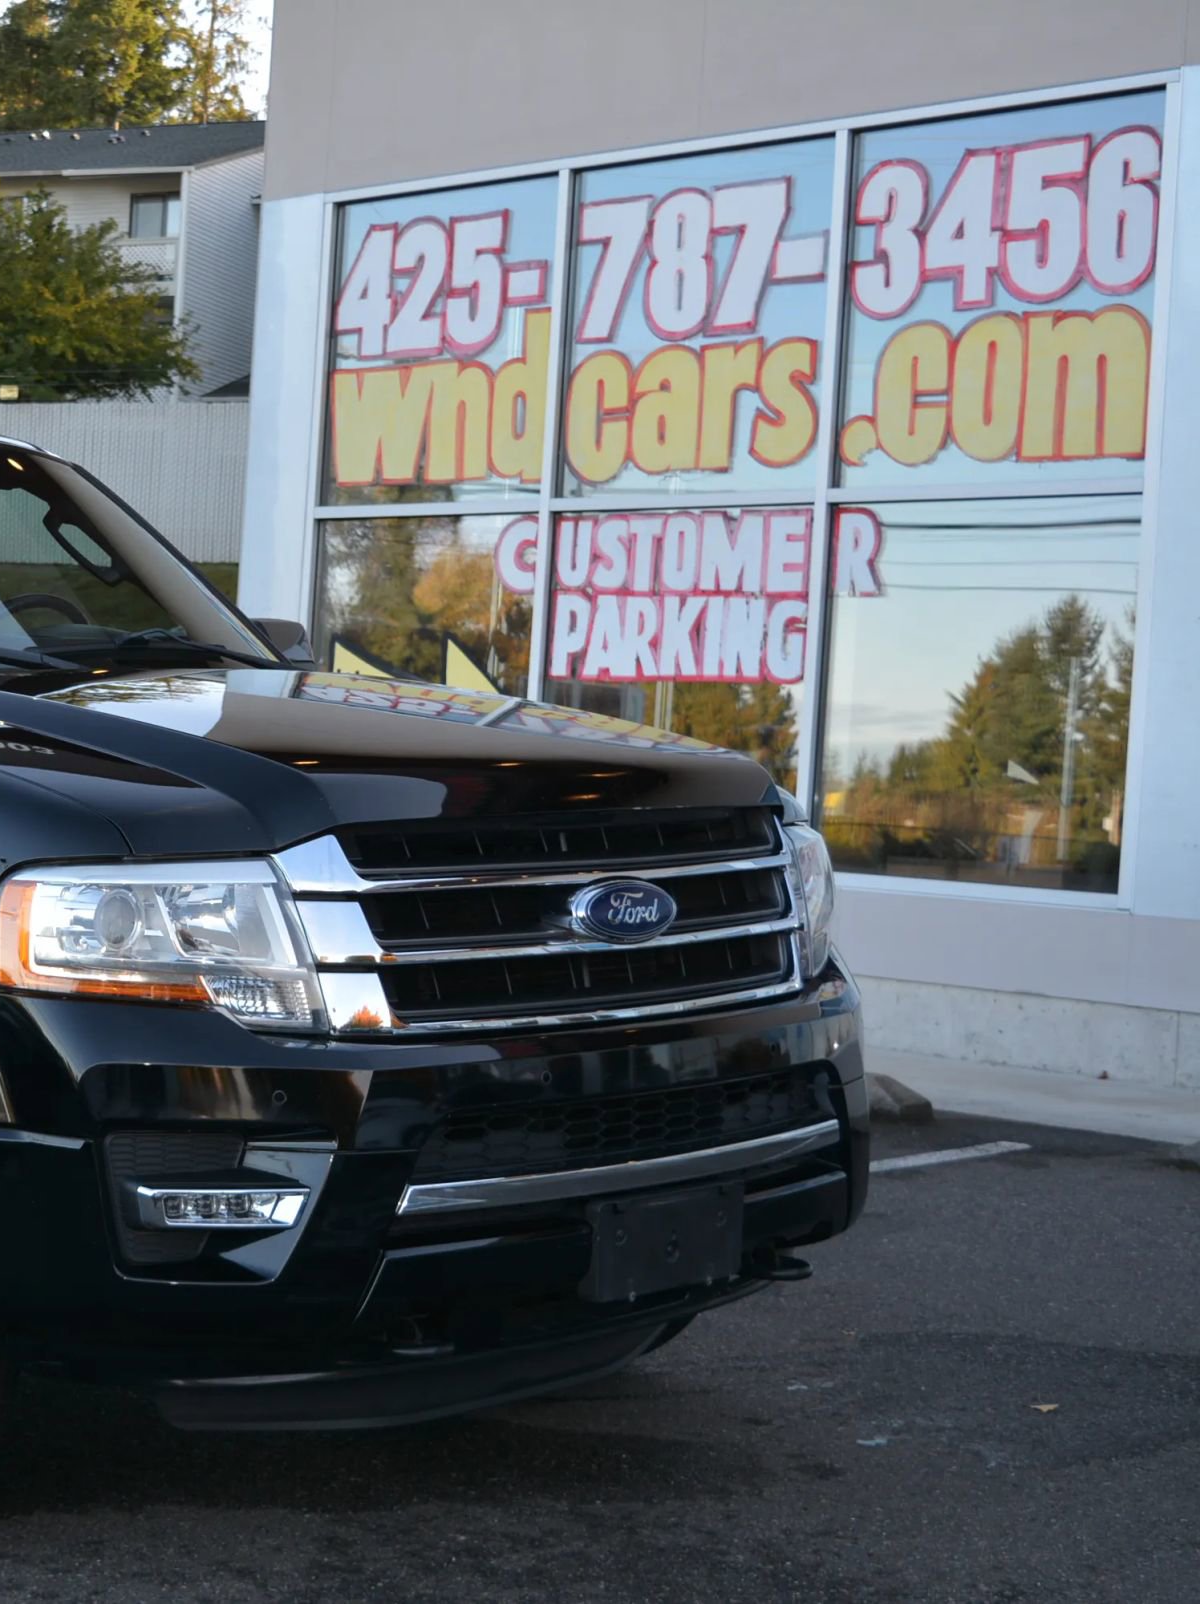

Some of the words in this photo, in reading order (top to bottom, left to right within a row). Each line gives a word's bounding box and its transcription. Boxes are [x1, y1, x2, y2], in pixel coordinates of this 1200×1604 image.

[494, 507, 883, 598] CUSTOMER
[547, 588, 809, 685] PARKING
[607, 891, 659, 925] Ford
